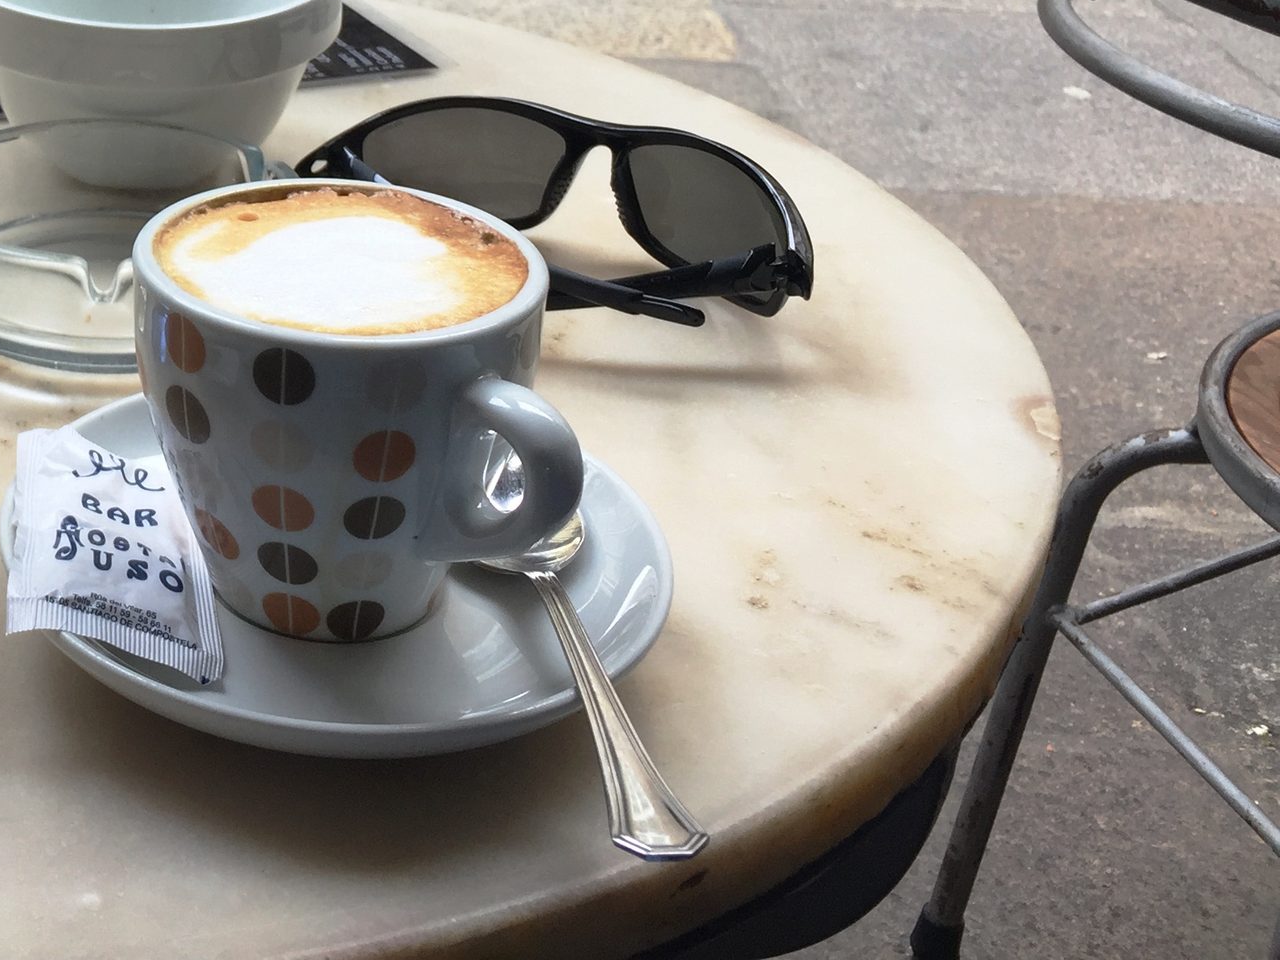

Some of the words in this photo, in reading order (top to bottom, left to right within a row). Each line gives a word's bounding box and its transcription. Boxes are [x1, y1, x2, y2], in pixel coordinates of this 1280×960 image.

[81, 492, 159, 527] BAR
[70, 600, 118, 622] SANTIAGO
[119, 617, 133, 628] DE
[134, 622, 198, 651] COMPOSTELA
[109, 604, 118, 614] 11
